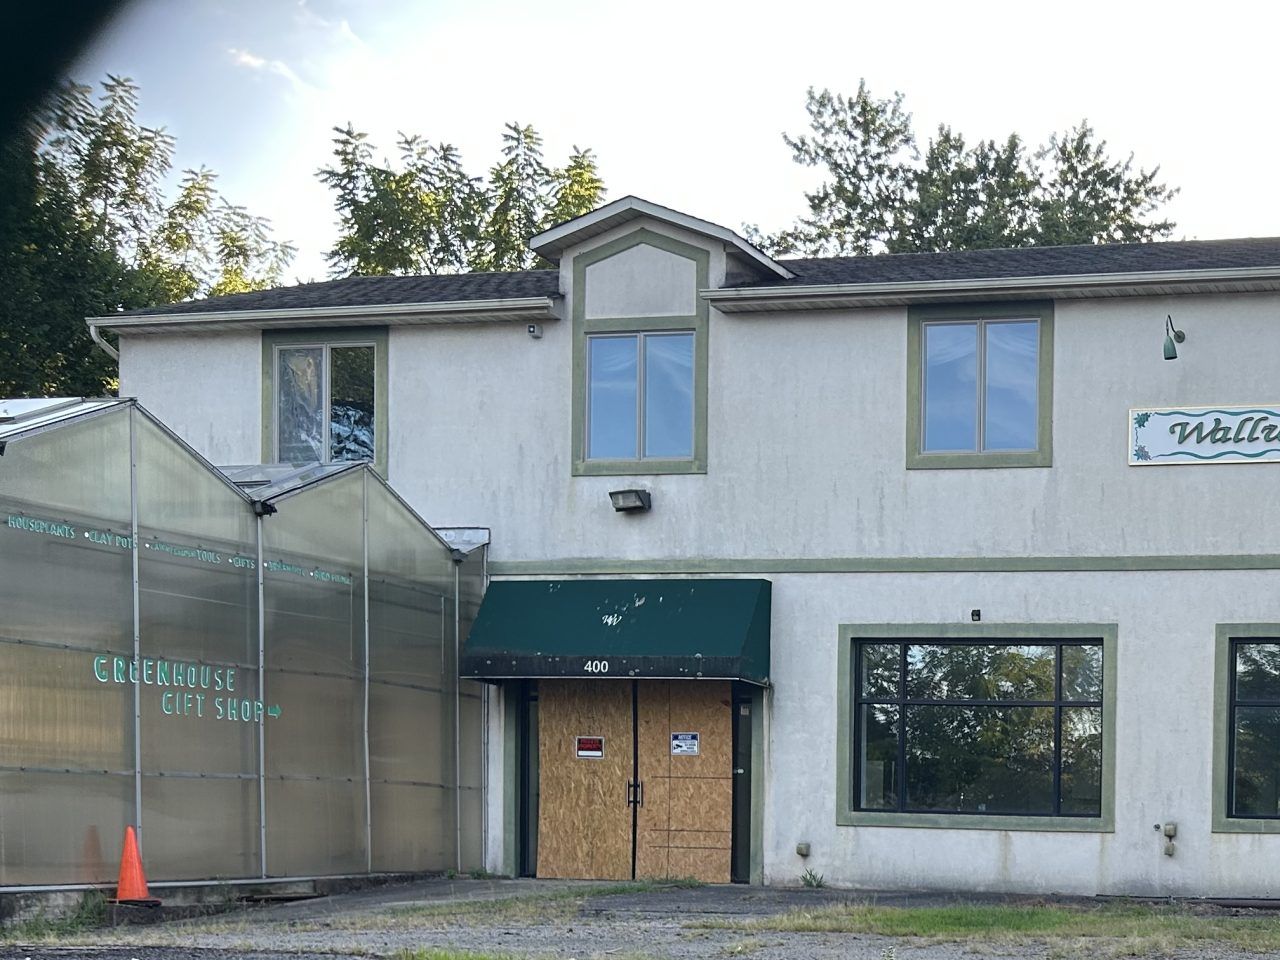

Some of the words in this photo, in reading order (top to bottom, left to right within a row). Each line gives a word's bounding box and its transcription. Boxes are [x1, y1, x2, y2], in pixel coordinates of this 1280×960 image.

[8, 515, 75, 539] HOUSEPLANTS
[88, 530, 113, 545] CLAY
[196, 549, 221, 564] TOOLS
[233, 557, 256, 569] GIFTS
[93, 656, 236, 692] GREENHOUSE
[583, 660, 609, 673] 400
[162, 691, 205, 718] GIFT
[215, 697, 264, 722] SHOP
